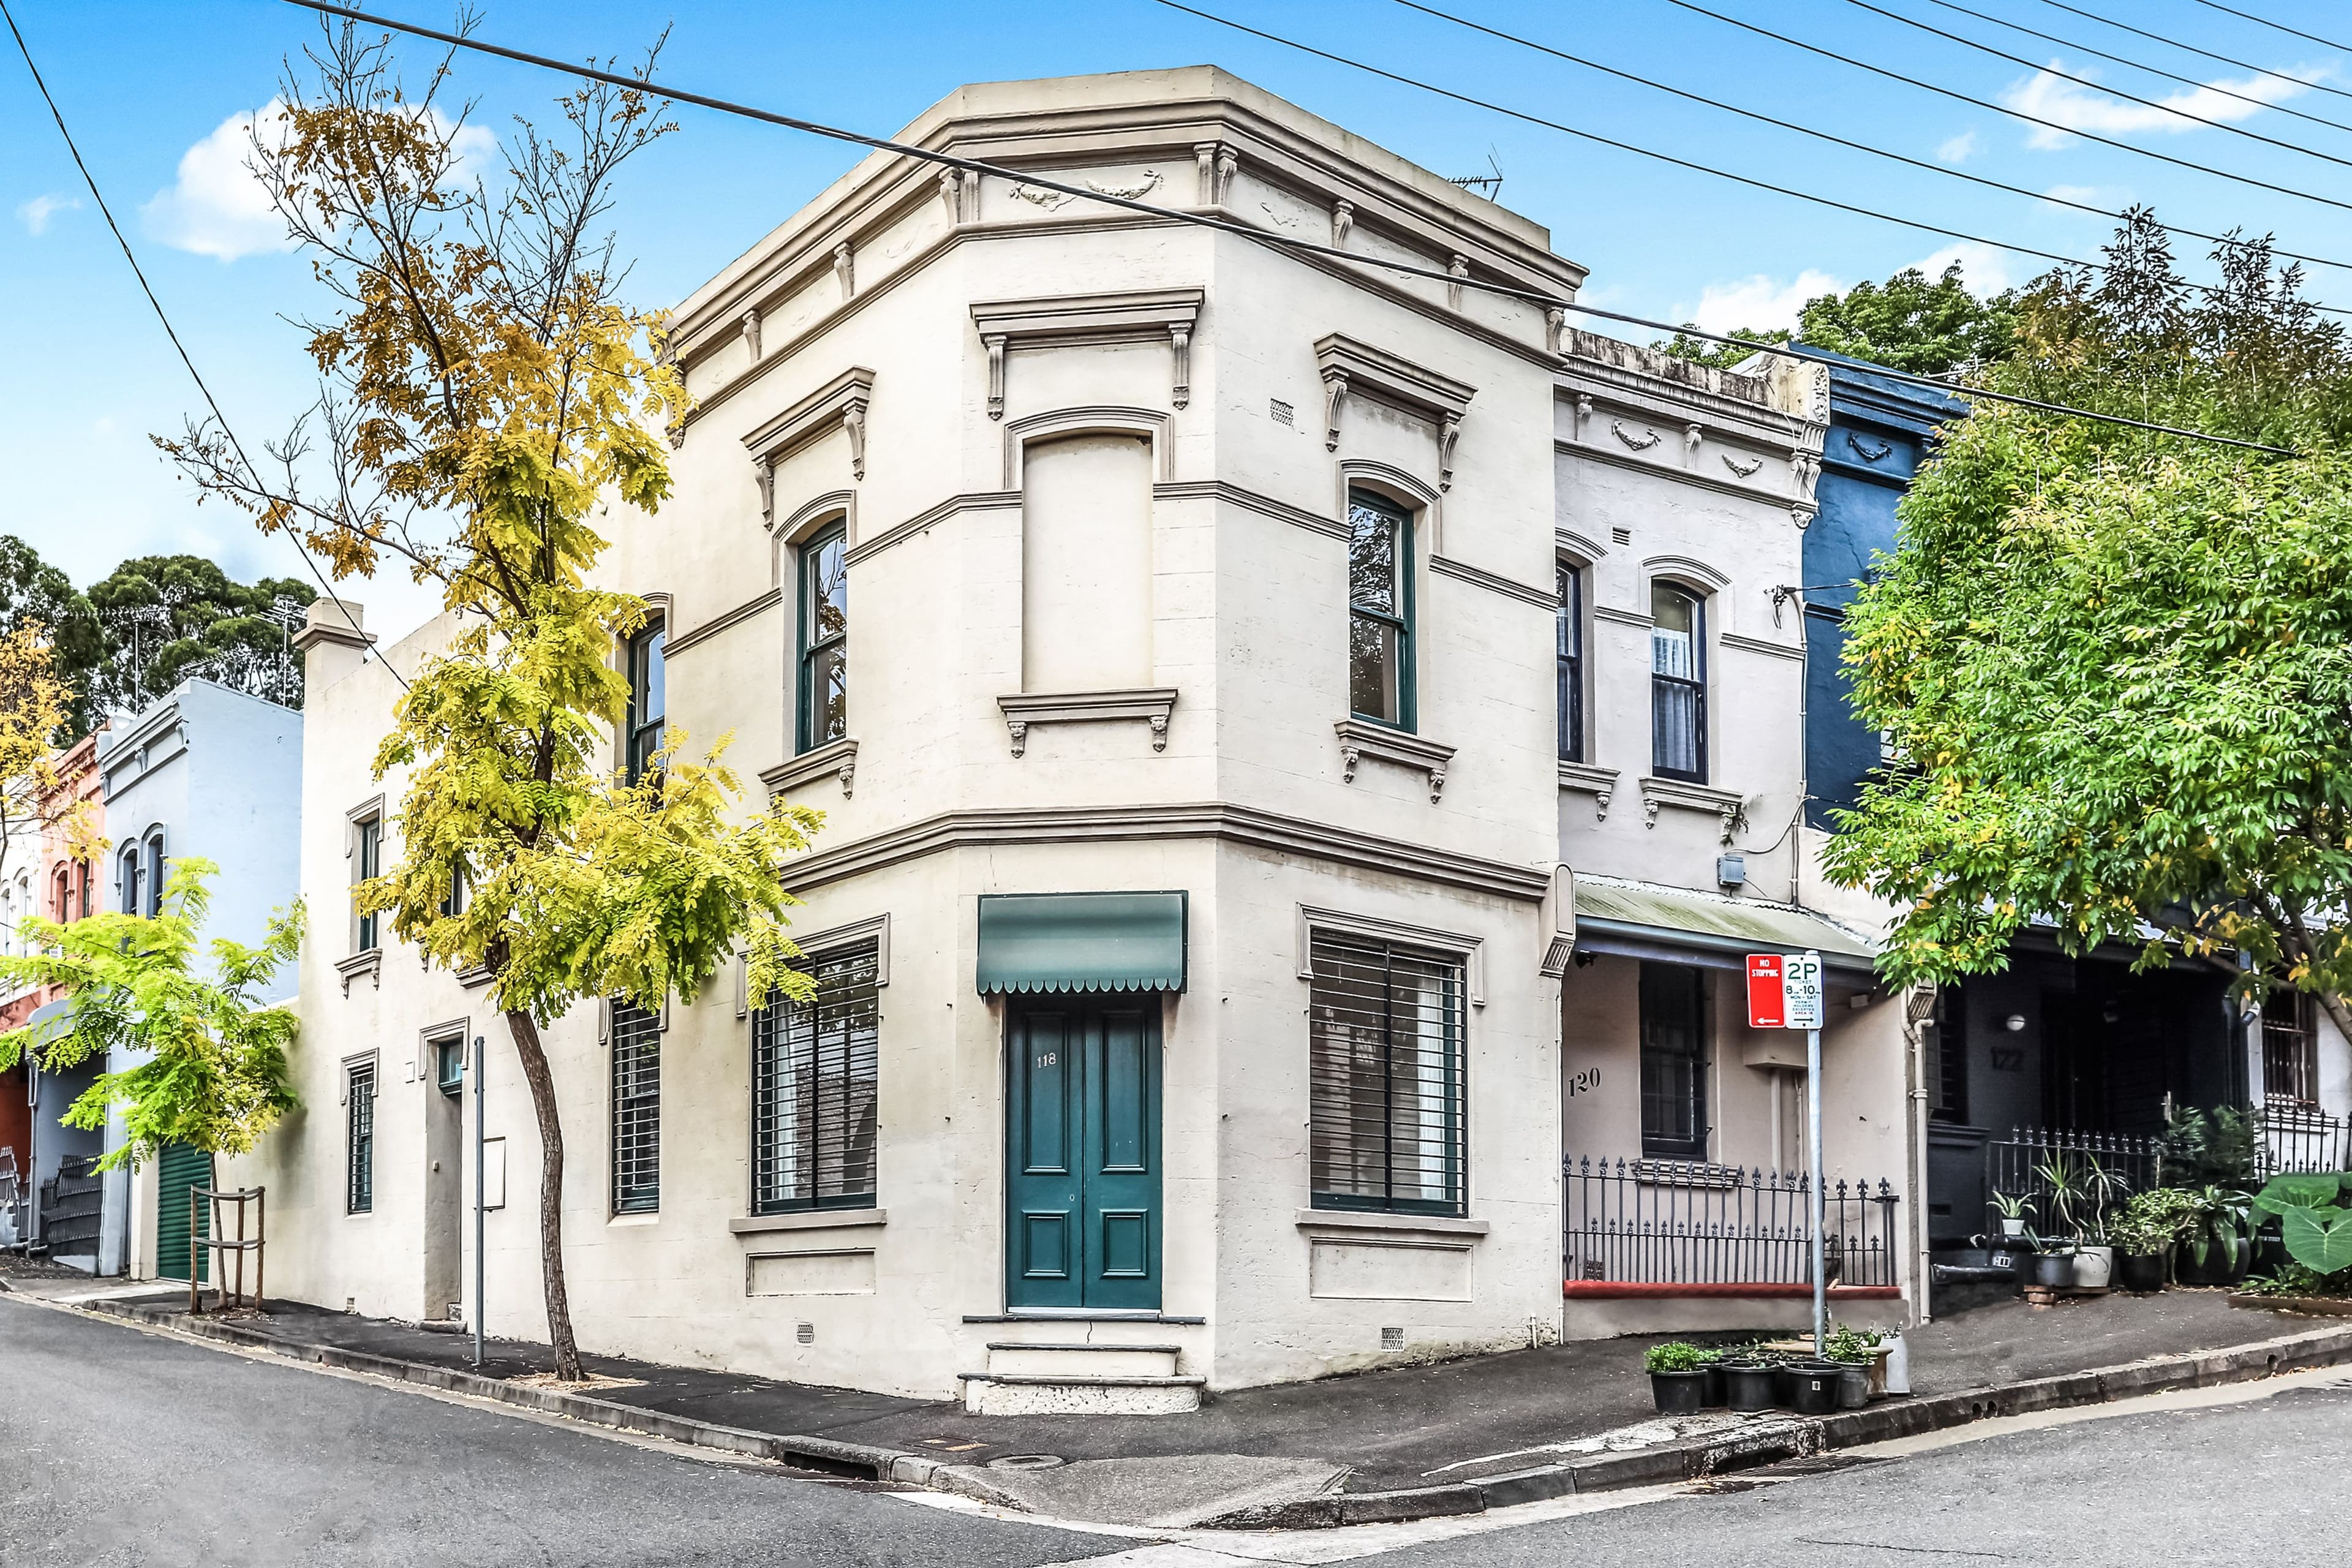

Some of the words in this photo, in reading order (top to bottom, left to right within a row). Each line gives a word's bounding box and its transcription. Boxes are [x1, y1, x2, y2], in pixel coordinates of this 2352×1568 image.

[1788, 963, 1817, 979] 2P
[1037, 1052, 1057, 1069] 118
[1568, 1068, 1600, 1097] 120
